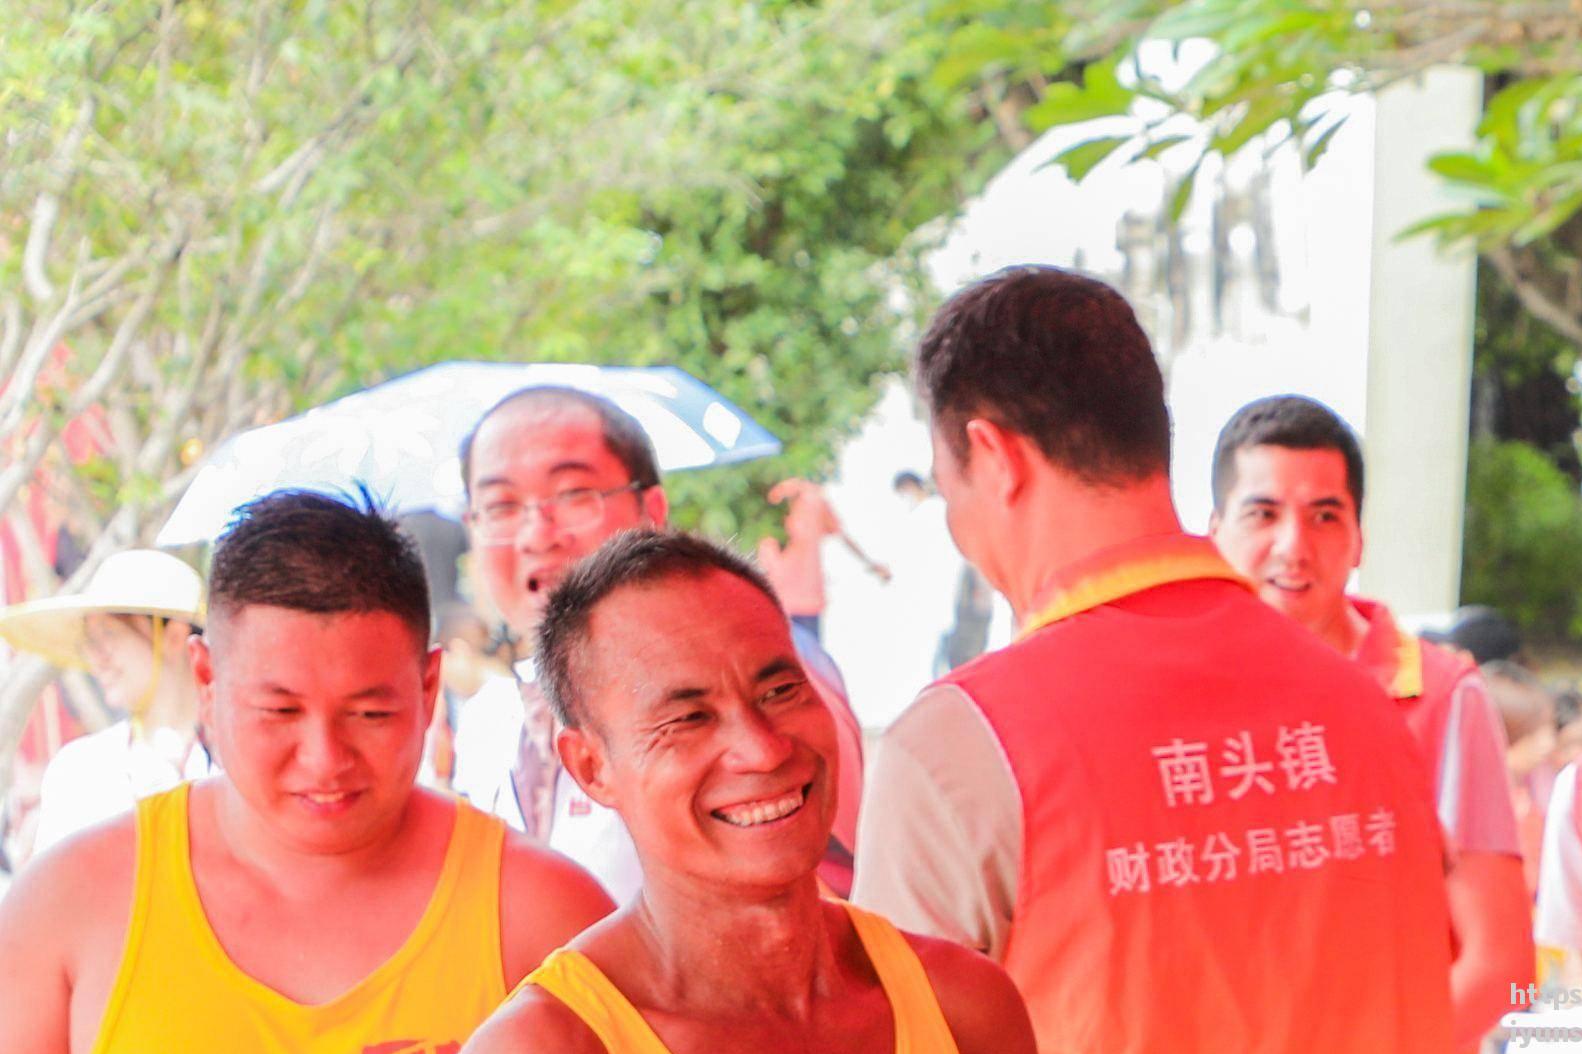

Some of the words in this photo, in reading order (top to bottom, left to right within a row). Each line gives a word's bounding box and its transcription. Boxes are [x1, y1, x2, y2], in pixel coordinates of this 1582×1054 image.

[1152, 721, 1338, 807] 南头镇
[1105, 806, 1398, 896] 财政分局志愿者
